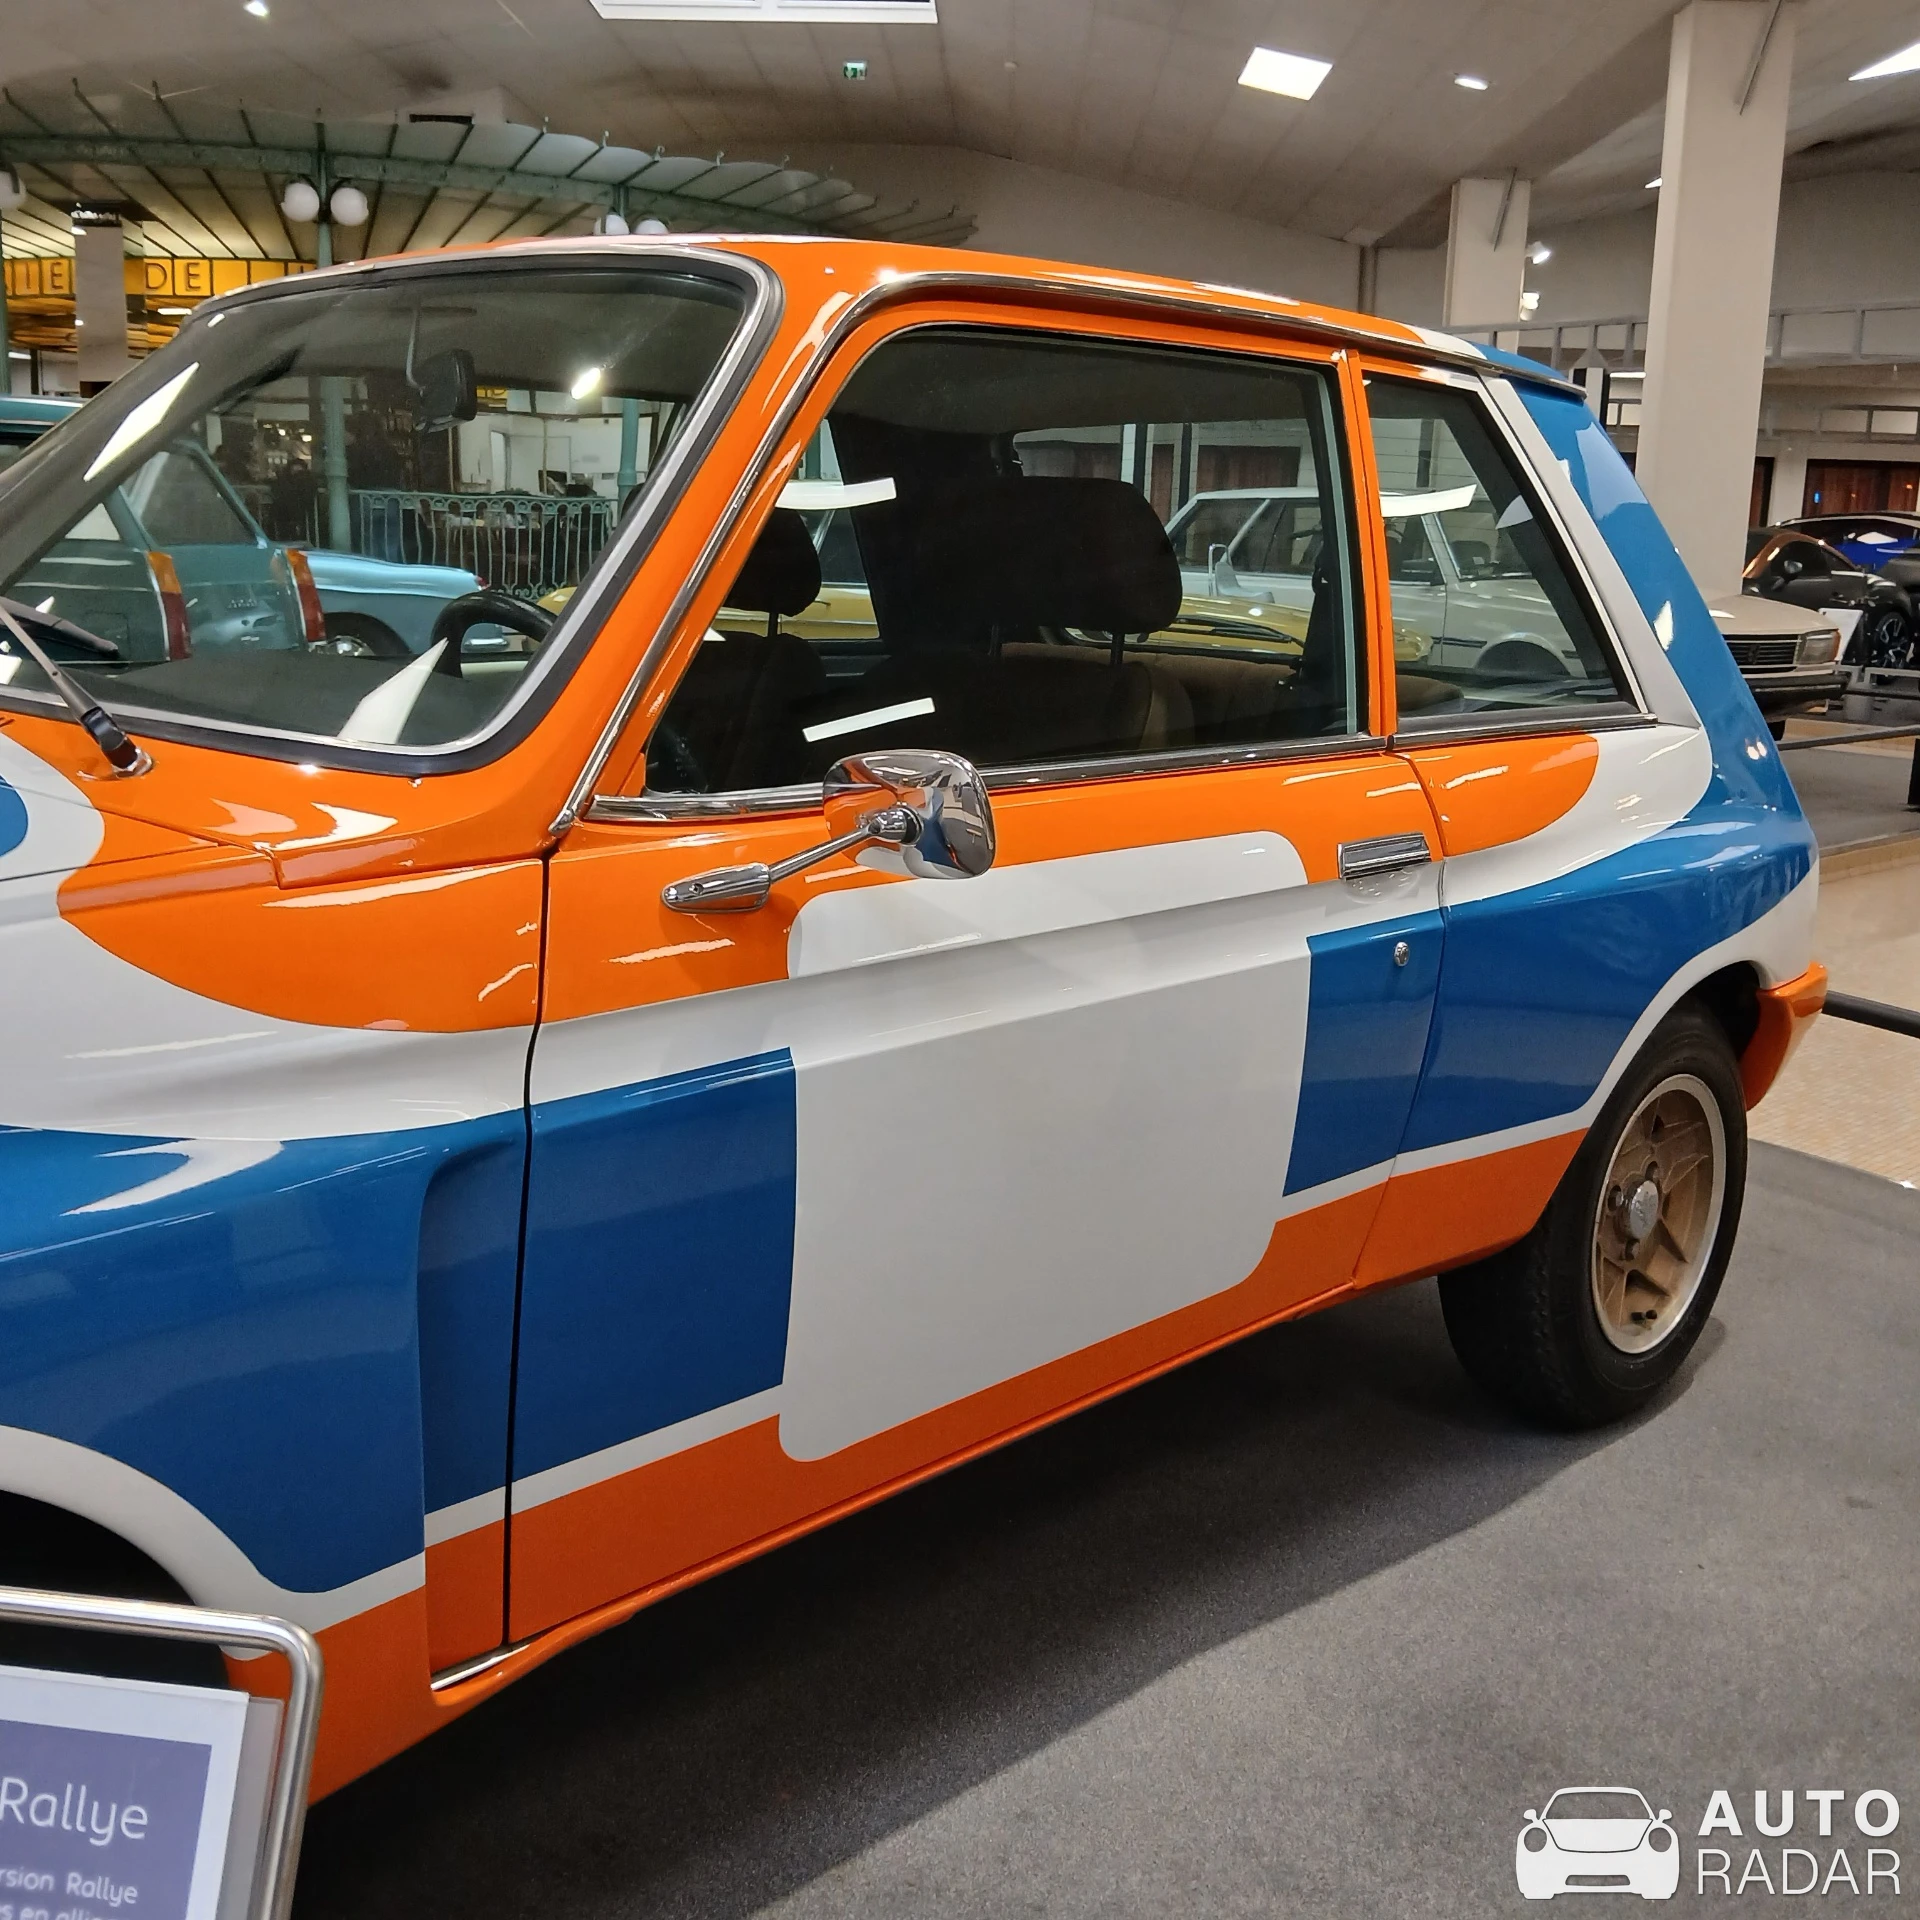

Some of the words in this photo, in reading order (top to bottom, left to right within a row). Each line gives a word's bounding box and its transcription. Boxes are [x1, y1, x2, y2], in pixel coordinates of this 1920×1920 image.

[5, 261, 63, 290] IE
[145, 262, 202, 289] DE
[0, 1776, 148, 1846] Rallye
[66, 1872, 138, 1907] Rallye
